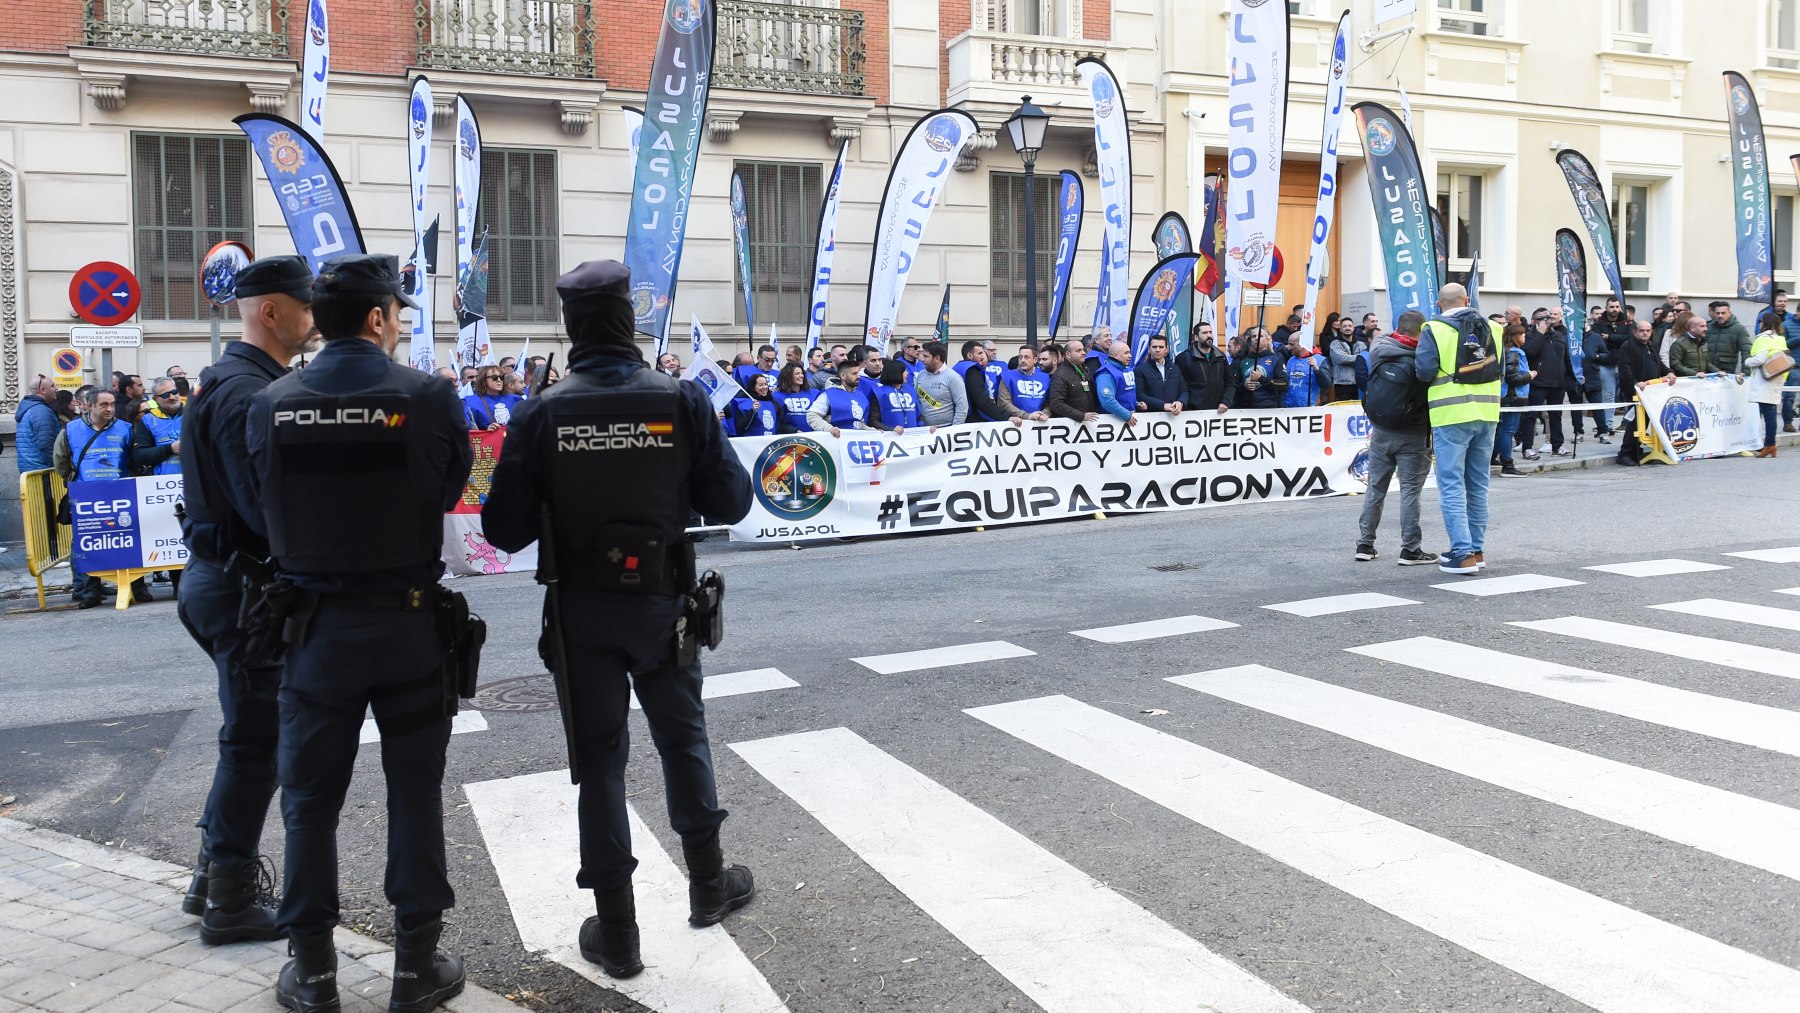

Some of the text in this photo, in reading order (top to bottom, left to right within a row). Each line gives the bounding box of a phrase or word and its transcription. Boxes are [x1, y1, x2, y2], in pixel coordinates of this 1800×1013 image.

[1141, 305, 1167, 318] CEP
[1016, 379, 1046, 395] CEP
[274, 408, 390, 426] POLICIA
[557, 422, 650, 439] POLICIA
[885, 440, 910, 458] A
[920, 427, 1022, 456] MISMO
[1031, 420, 1176, 446] TRABAJO,
[558, 435, 674, 452] NACIONAL
[847, 440, 885, 465] CEP
[948, 437, 1276, 477] SALARIO Y JUBILACIÓN
[155, 480, 185, 491] LOS
[876, 464, 1338, 530] #EQUIPARACIONYA
[75, 499, 132, 515] CEP
[755, 524, 841, 538] JUSAPOL
[79, 532, 134, 552] Galicia
